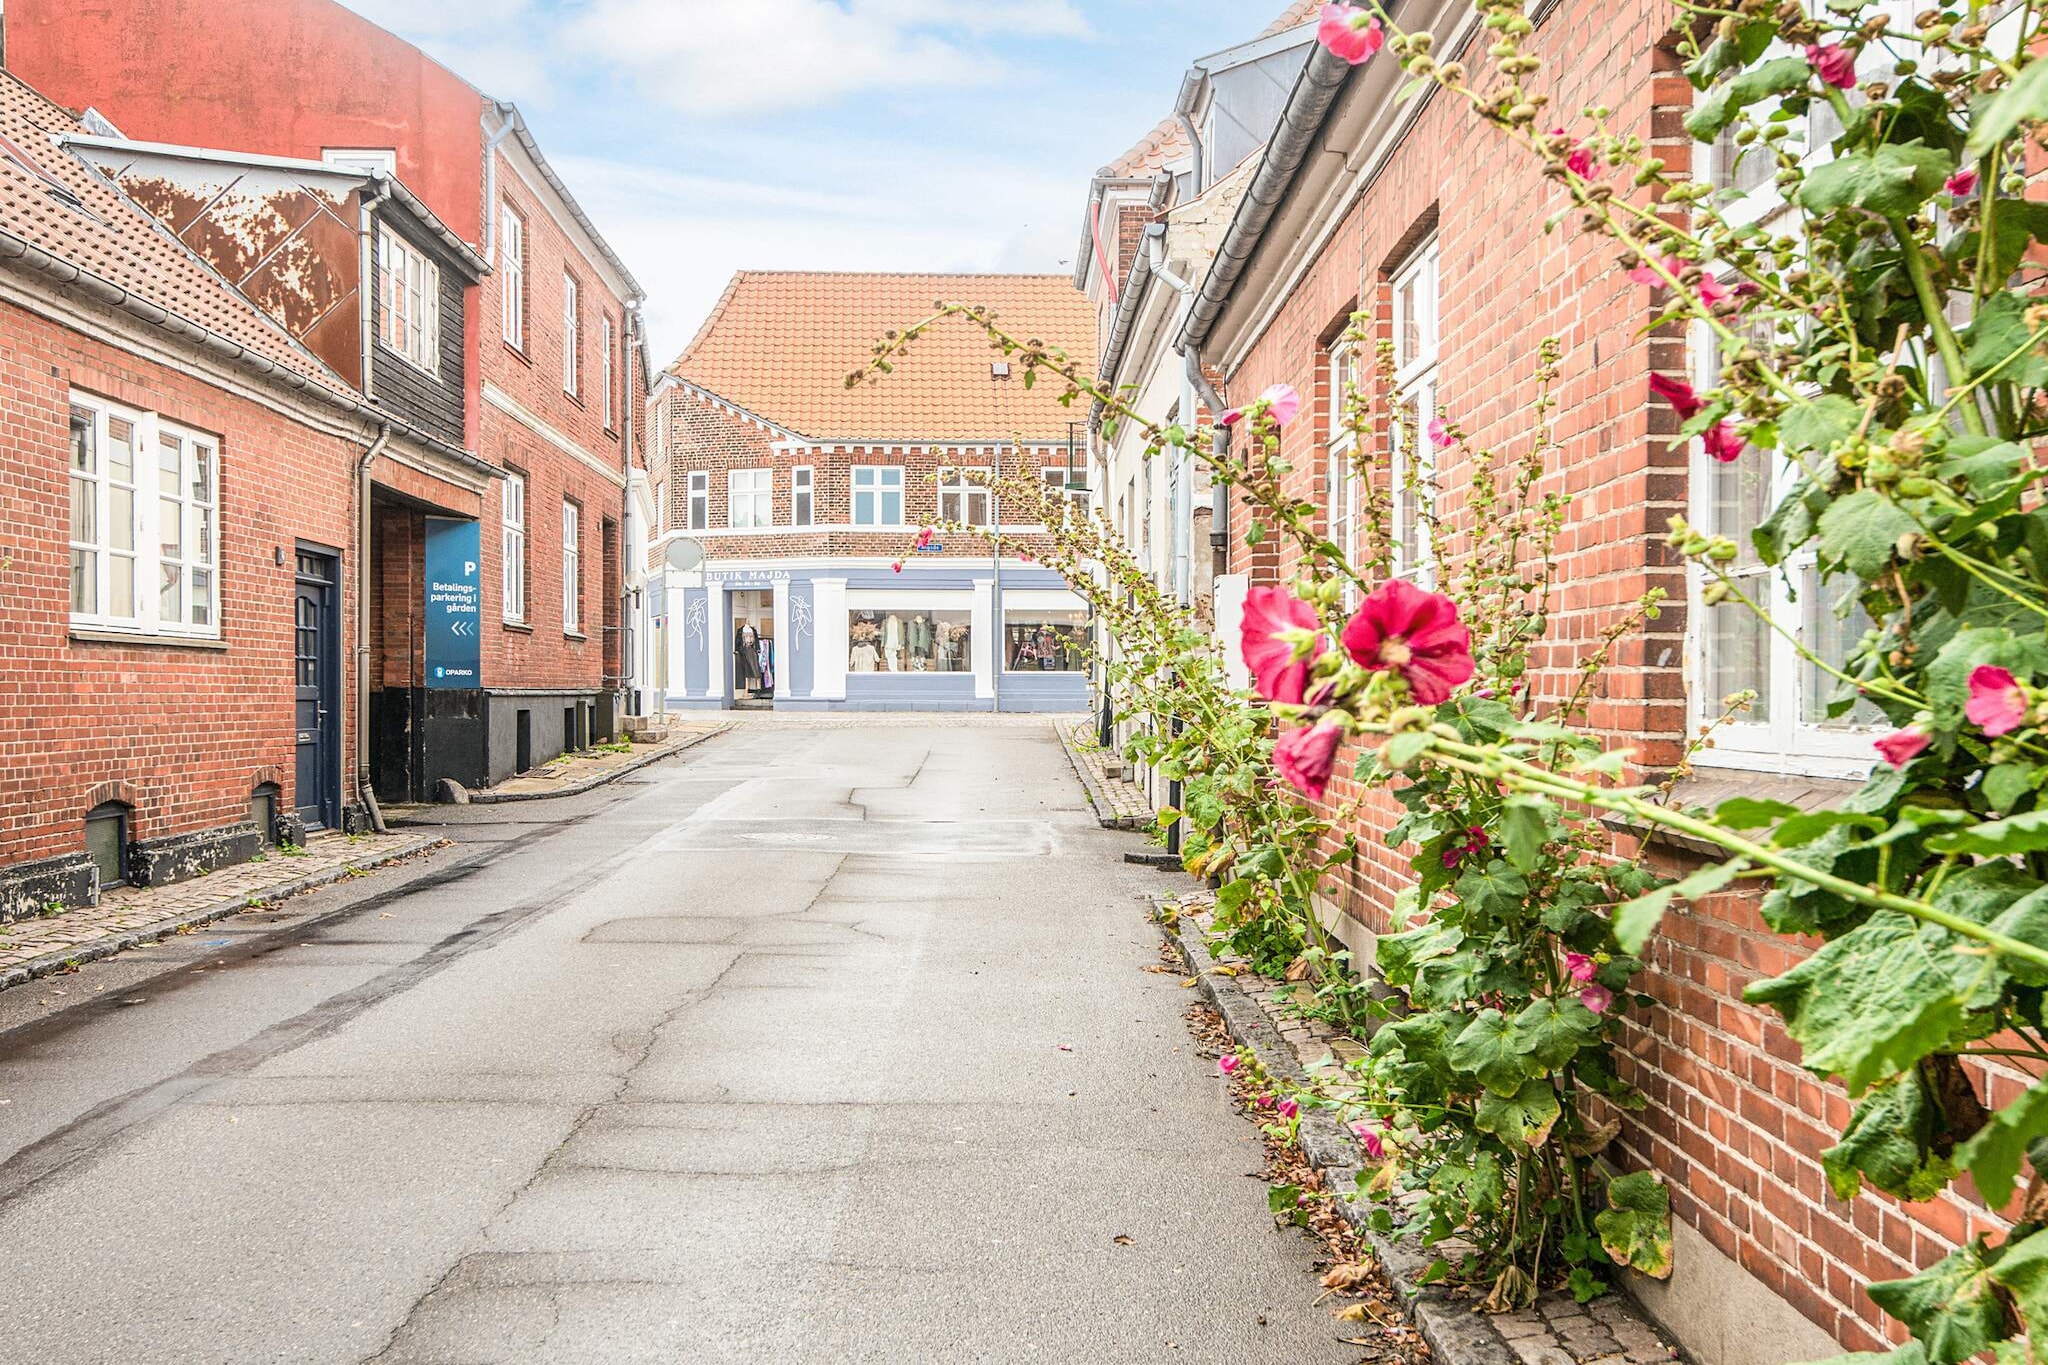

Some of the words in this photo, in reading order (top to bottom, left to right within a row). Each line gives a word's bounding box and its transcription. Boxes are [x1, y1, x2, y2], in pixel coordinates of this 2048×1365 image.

[465, 561, 476, 576] P
[706, 571, 742, 580] BUTIK
[749, 570, 790, 580] MAJDA
[433, 582, 476, 593] Betalings-
[431, 593, 471, 603] parkering
[446, 603, 476, 613] gården
